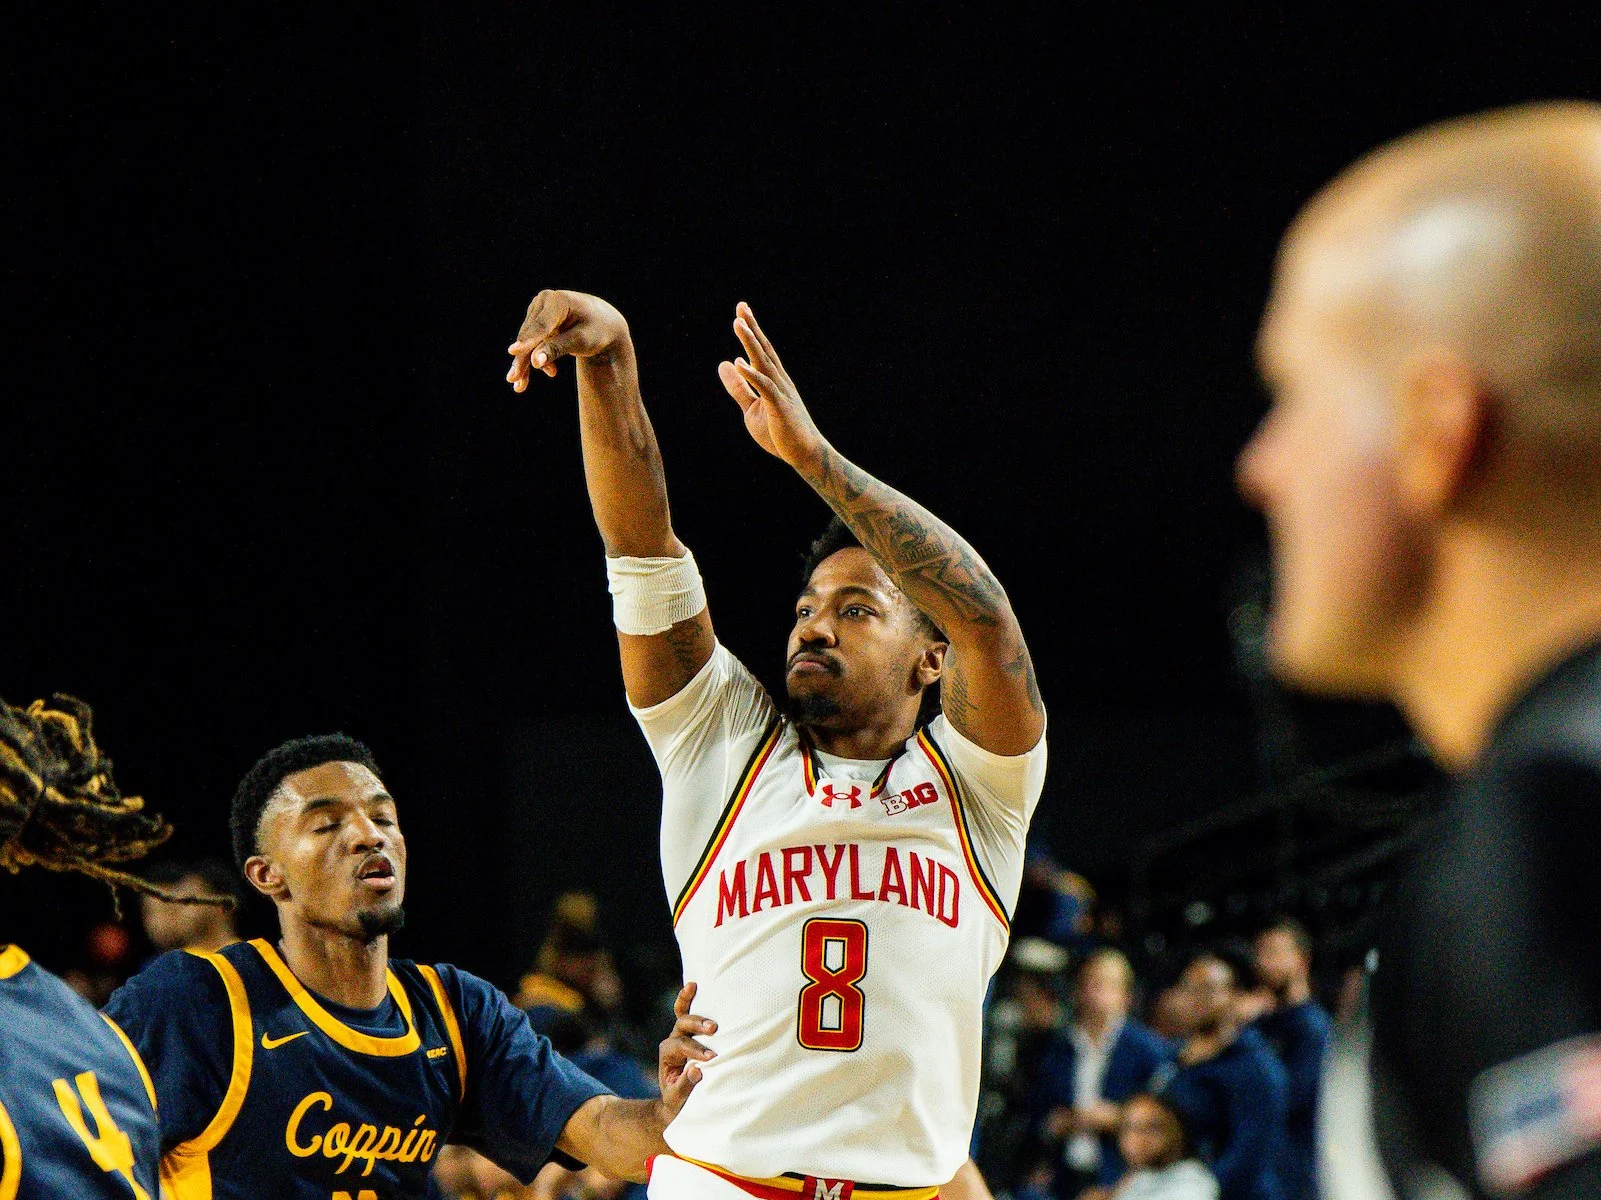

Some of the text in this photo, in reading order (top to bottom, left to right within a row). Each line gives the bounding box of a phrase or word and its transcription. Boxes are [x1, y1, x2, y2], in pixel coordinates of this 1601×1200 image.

[714, 843, 960, 929] MARYLAND
[797, 917, 869, 1051] 8
[285, 1091, 437, 1177] Coppin
